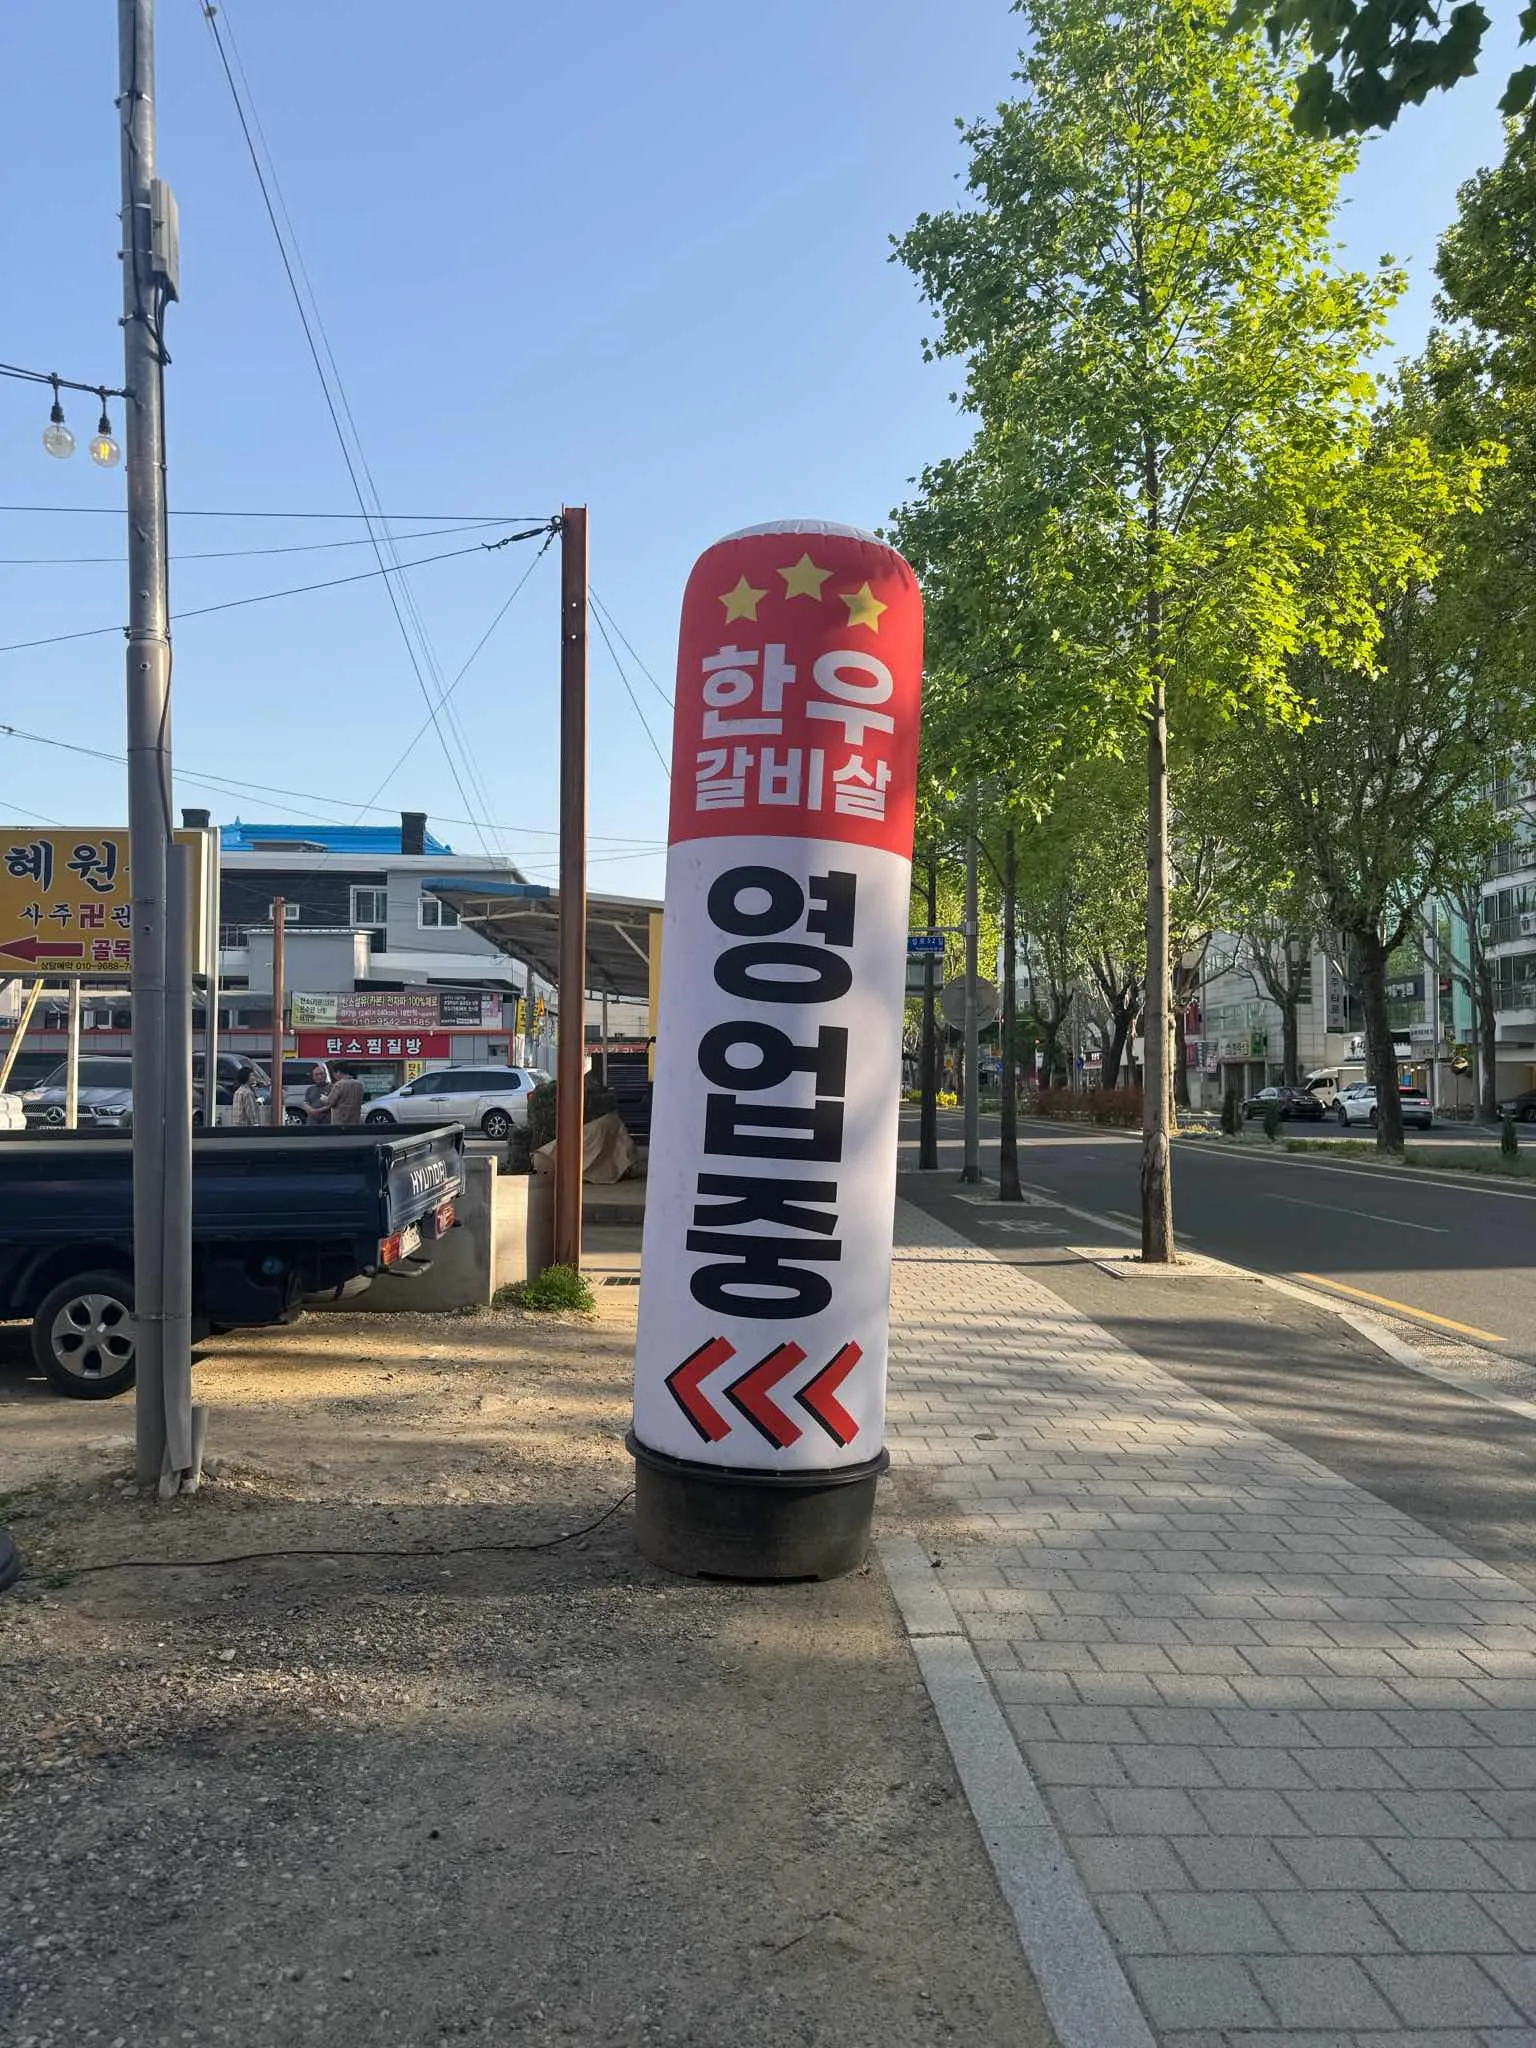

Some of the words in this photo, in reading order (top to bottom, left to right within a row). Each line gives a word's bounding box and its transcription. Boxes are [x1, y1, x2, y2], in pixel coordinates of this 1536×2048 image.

[701, 643, 895, 746] 한우
[695, 746, 892, 822] 갈비살
[326, 1037, 422, 1055] 탄소찜질방
[685, 865, 858, 1320] 영업중
[410, 1159, 448, 1195] HYUNDAI
